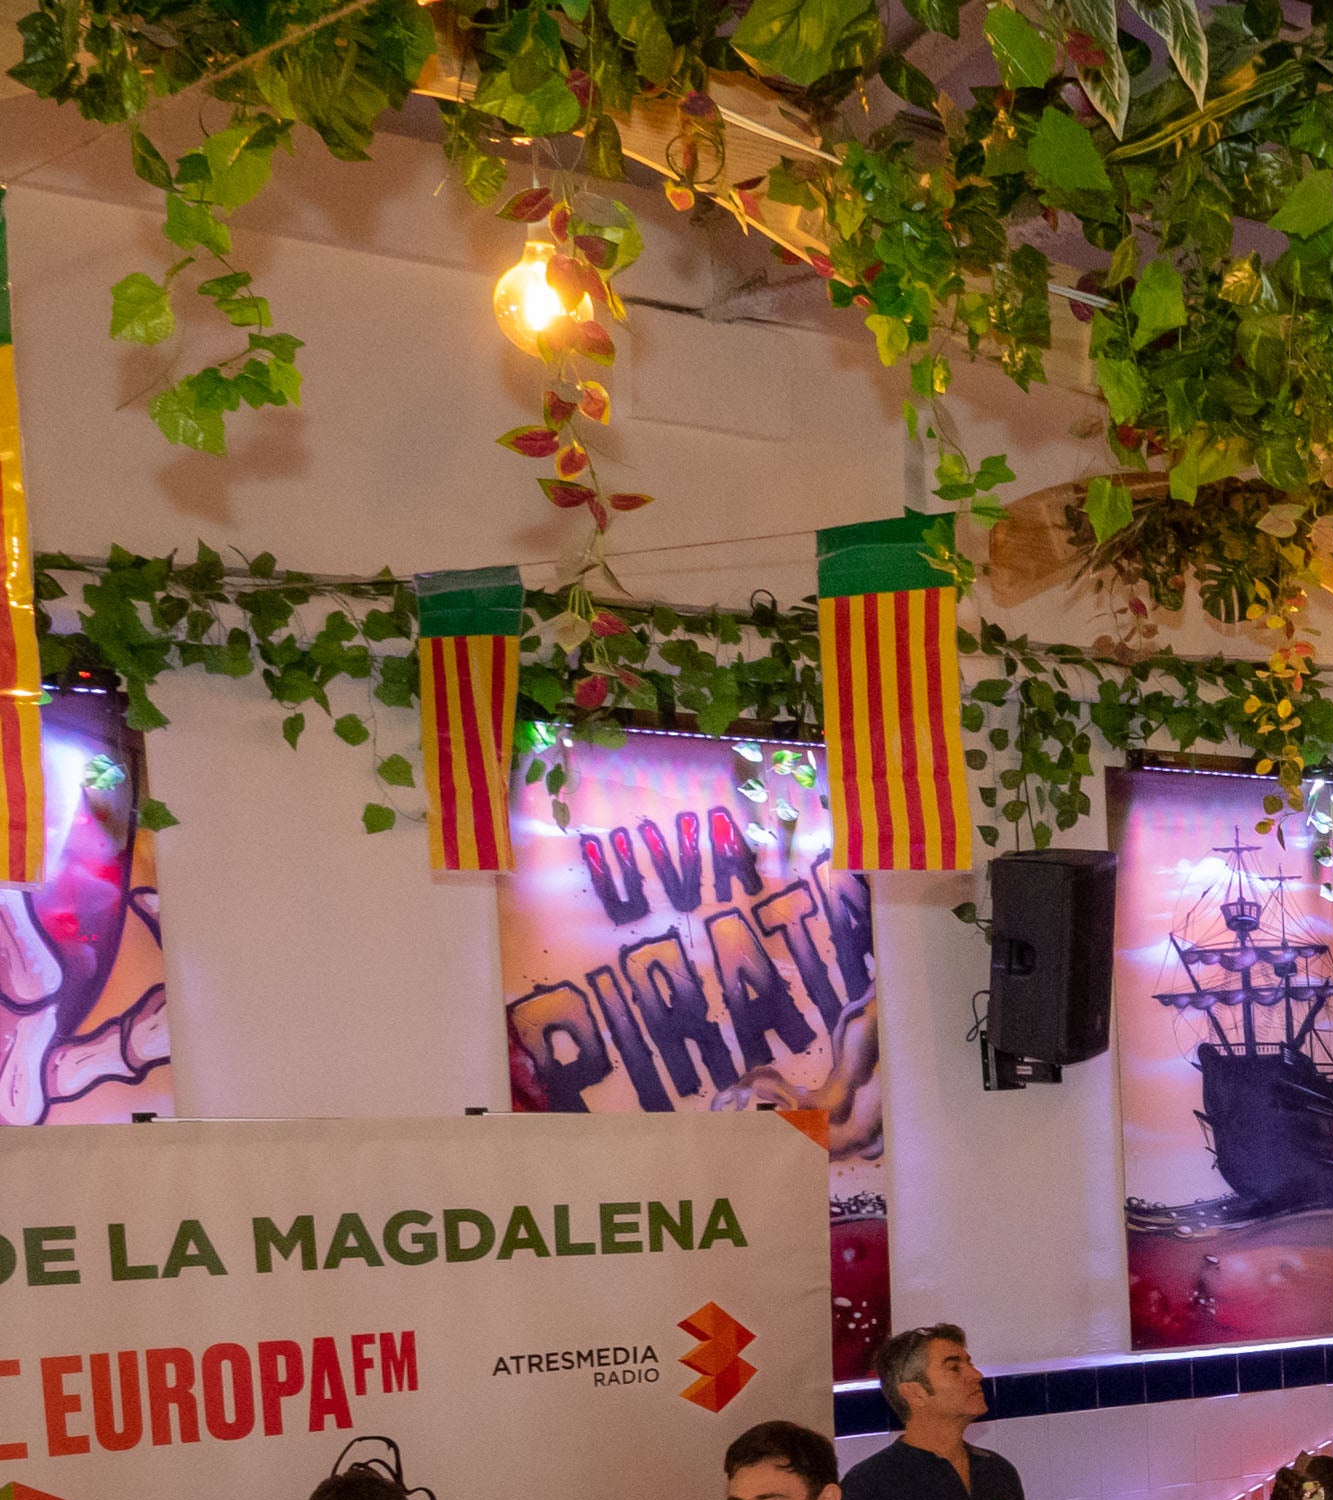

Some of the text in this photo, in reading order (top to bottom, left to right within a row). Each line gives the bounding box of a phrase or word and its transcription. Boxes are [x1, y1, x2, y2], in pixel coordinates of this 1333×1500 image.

[580, 806, 764, 926] UVA
[0, 1197, 748, 1288] E LA MAGDALENA
[492, 1345, 659, 1376] ATRESMEDIA
[594, 1368, 660, 1387] RADIO
